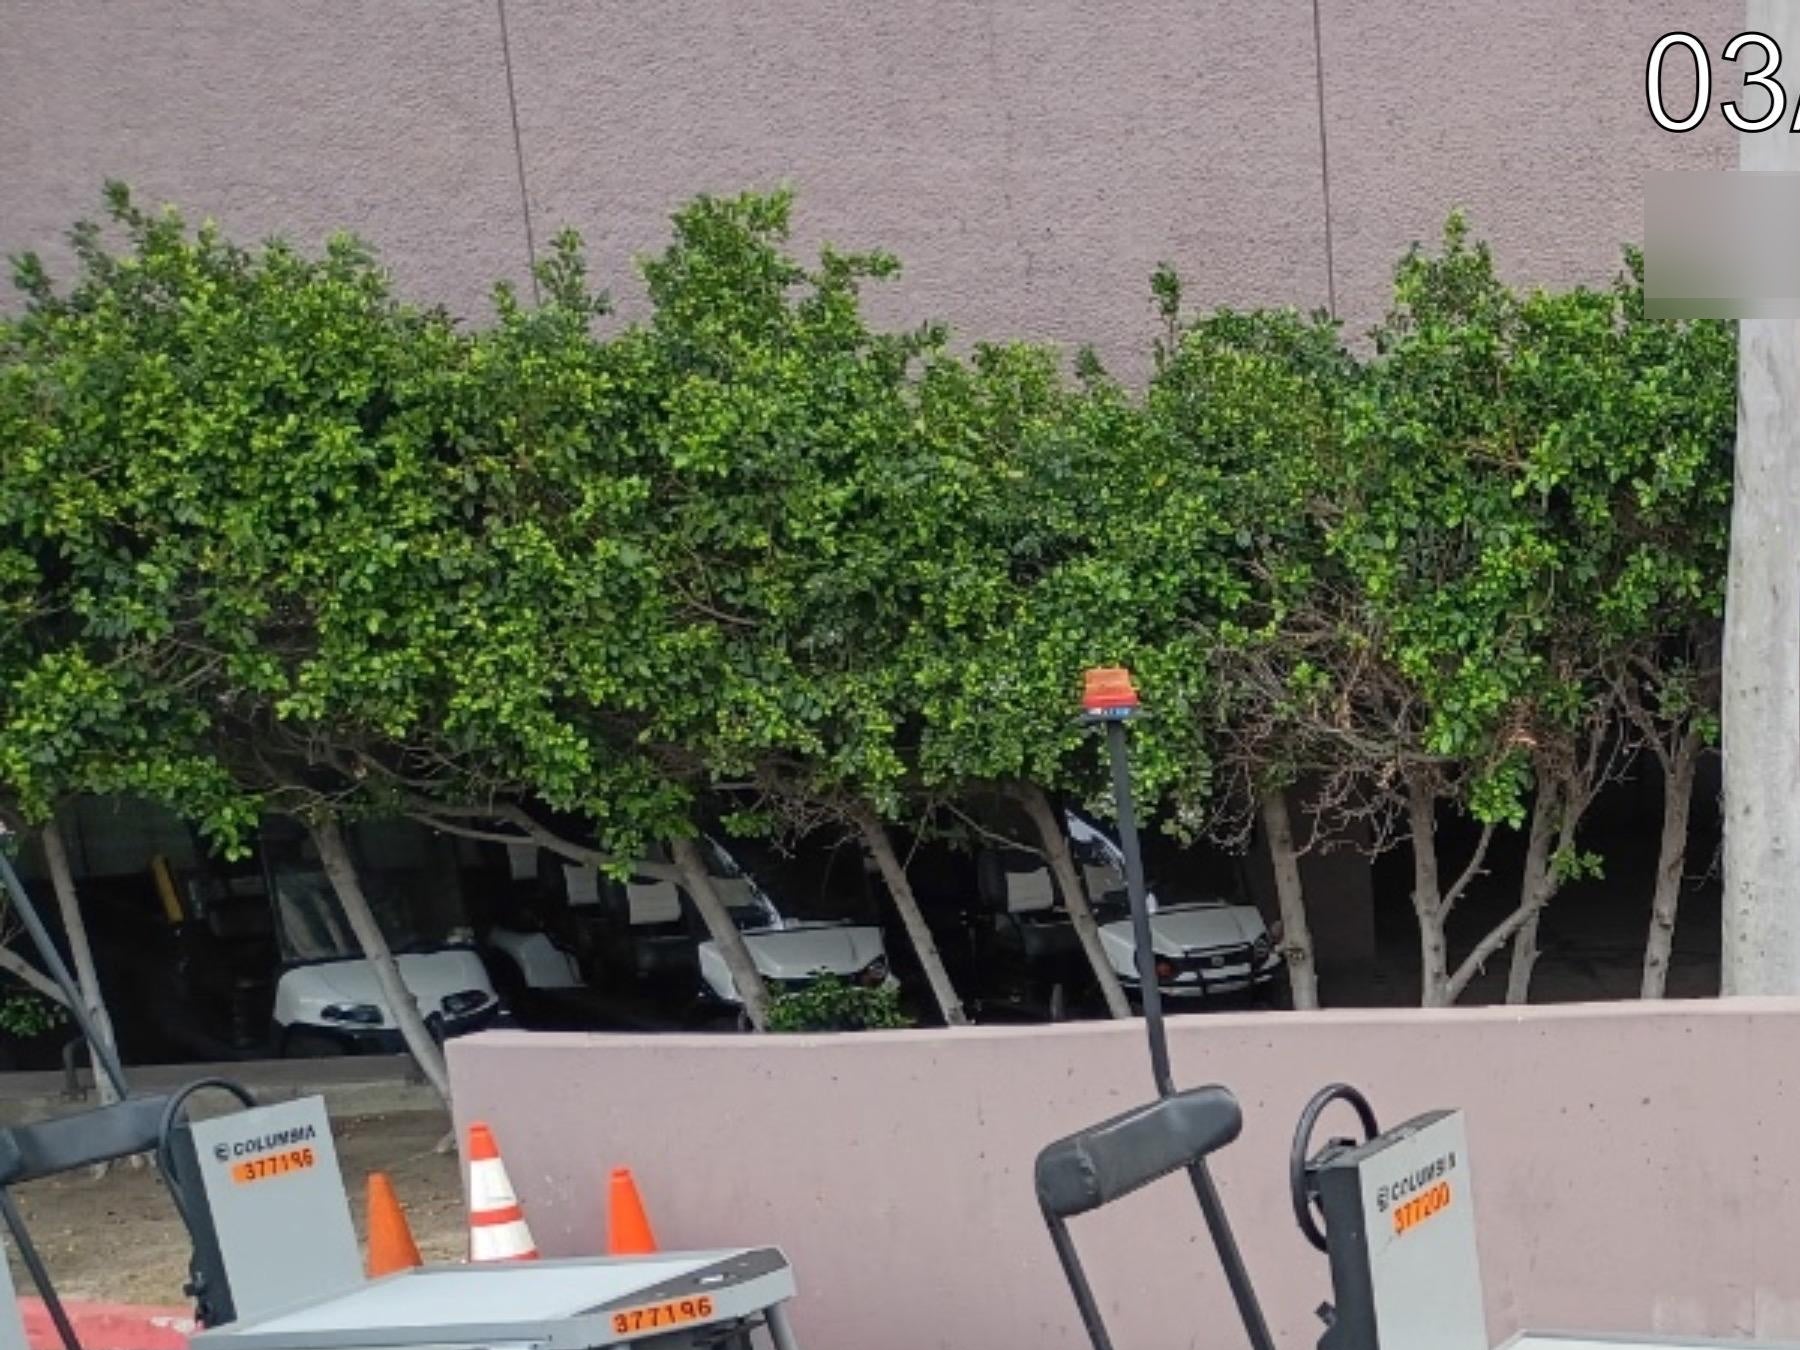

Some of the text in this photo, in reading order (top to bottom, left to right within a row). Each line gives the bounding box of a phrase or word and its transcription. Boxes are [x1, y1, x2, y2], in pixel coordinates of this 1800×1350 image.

[233, 1124, 316, 1156] COLUMBIA
[244, 1148, 314, 1181] 377196
[614, 1297, 713, 1334] 377196
